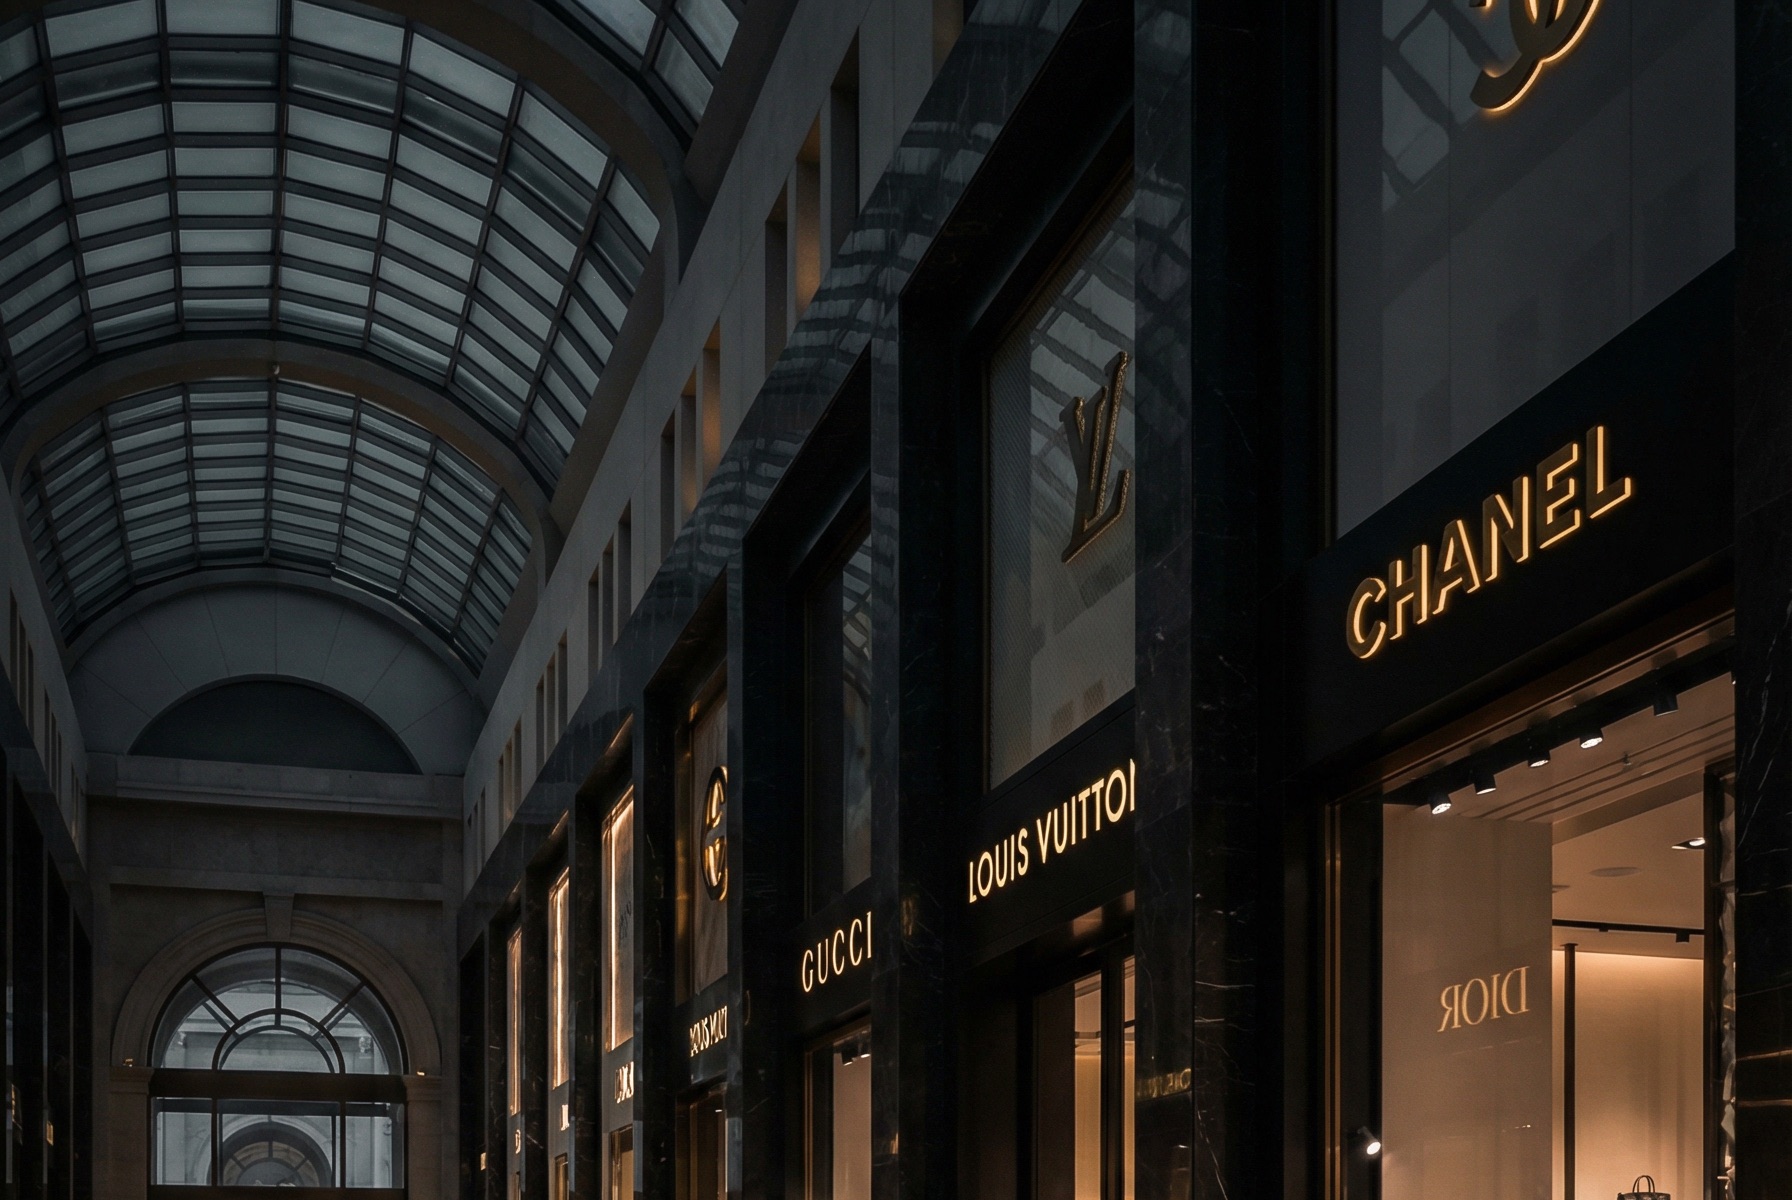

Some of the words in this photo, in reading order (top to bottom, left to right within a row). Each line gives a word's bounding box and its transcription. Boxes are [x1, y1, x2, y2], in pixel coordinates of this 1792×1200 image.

[1346, 425, 1632, 659] CHANEL
[968, 827, 1029, 904] LOUIS
[802, 911, 872, 993] GUCCI
